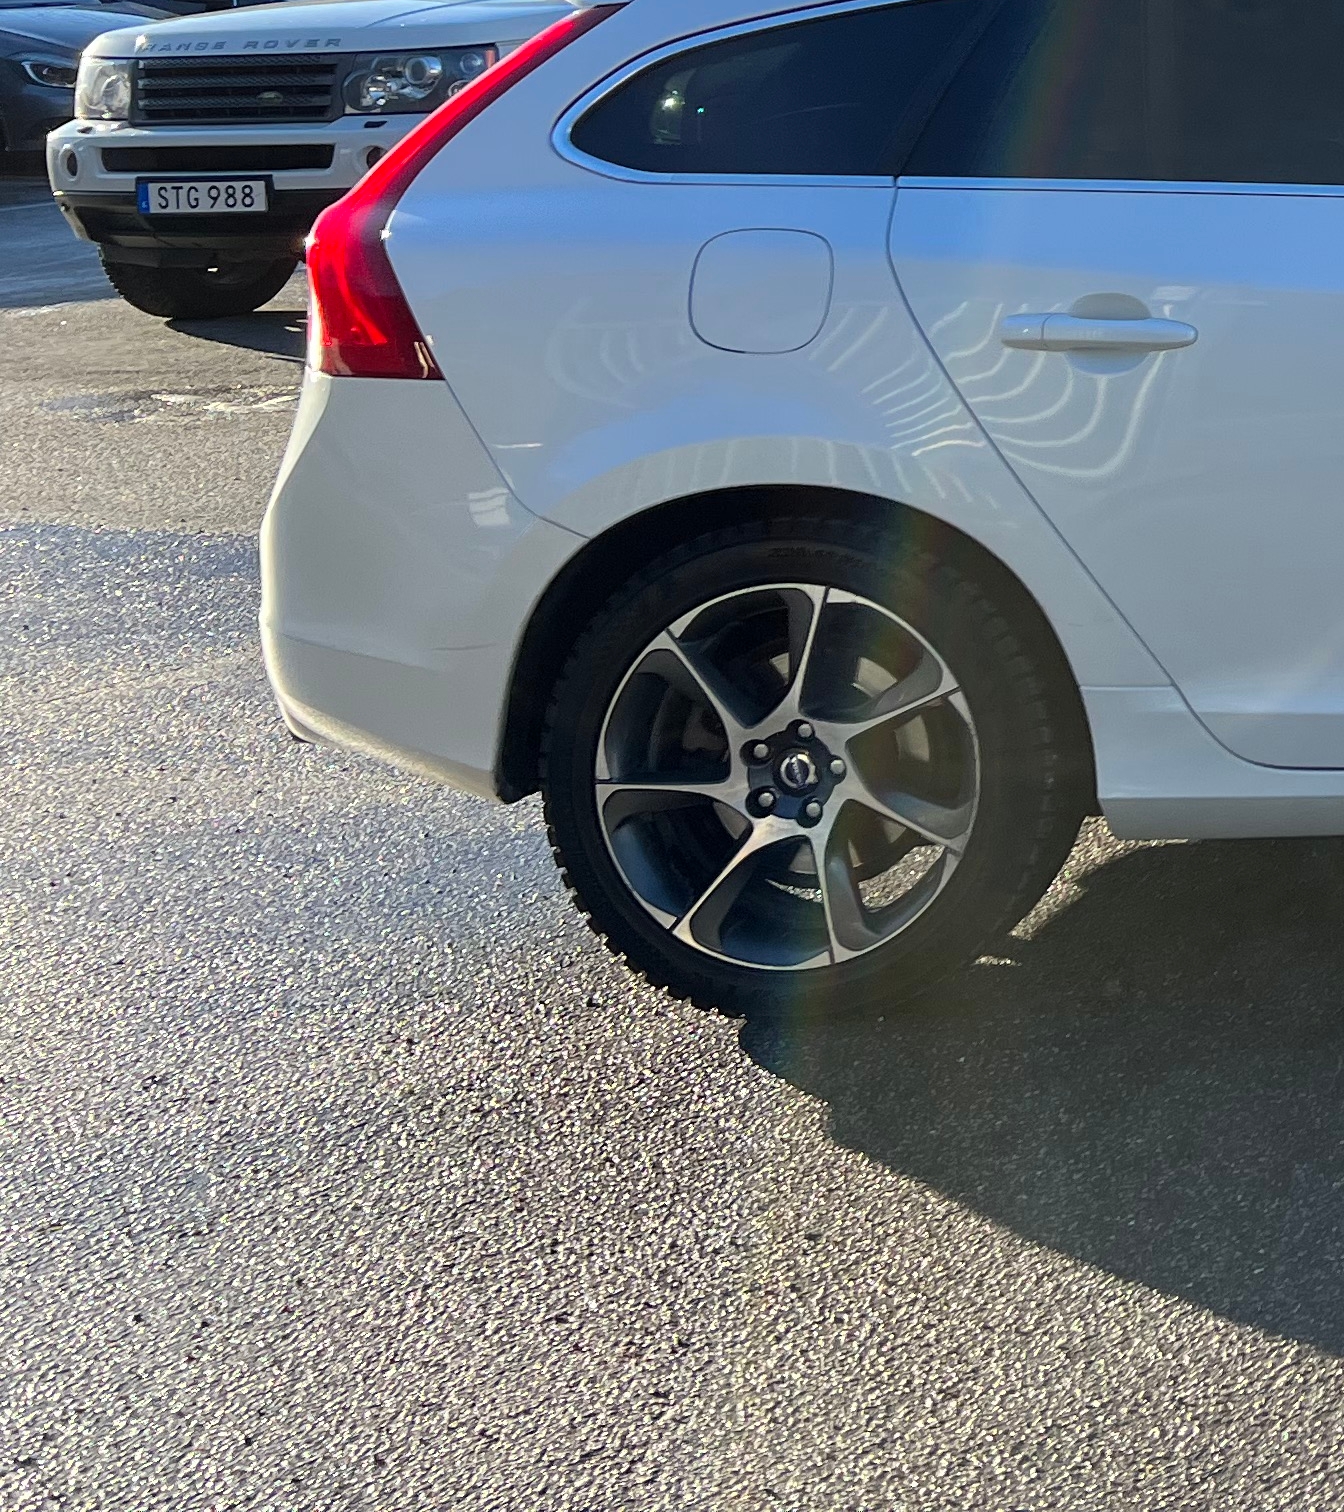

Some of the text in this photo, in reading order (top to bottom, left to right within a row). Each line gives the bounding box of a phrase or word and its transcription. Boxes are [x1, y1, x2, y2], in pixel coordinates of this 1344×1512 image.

[242, 38, 341, 50] ROVER
[158, 185, 254, 209] STG 988
